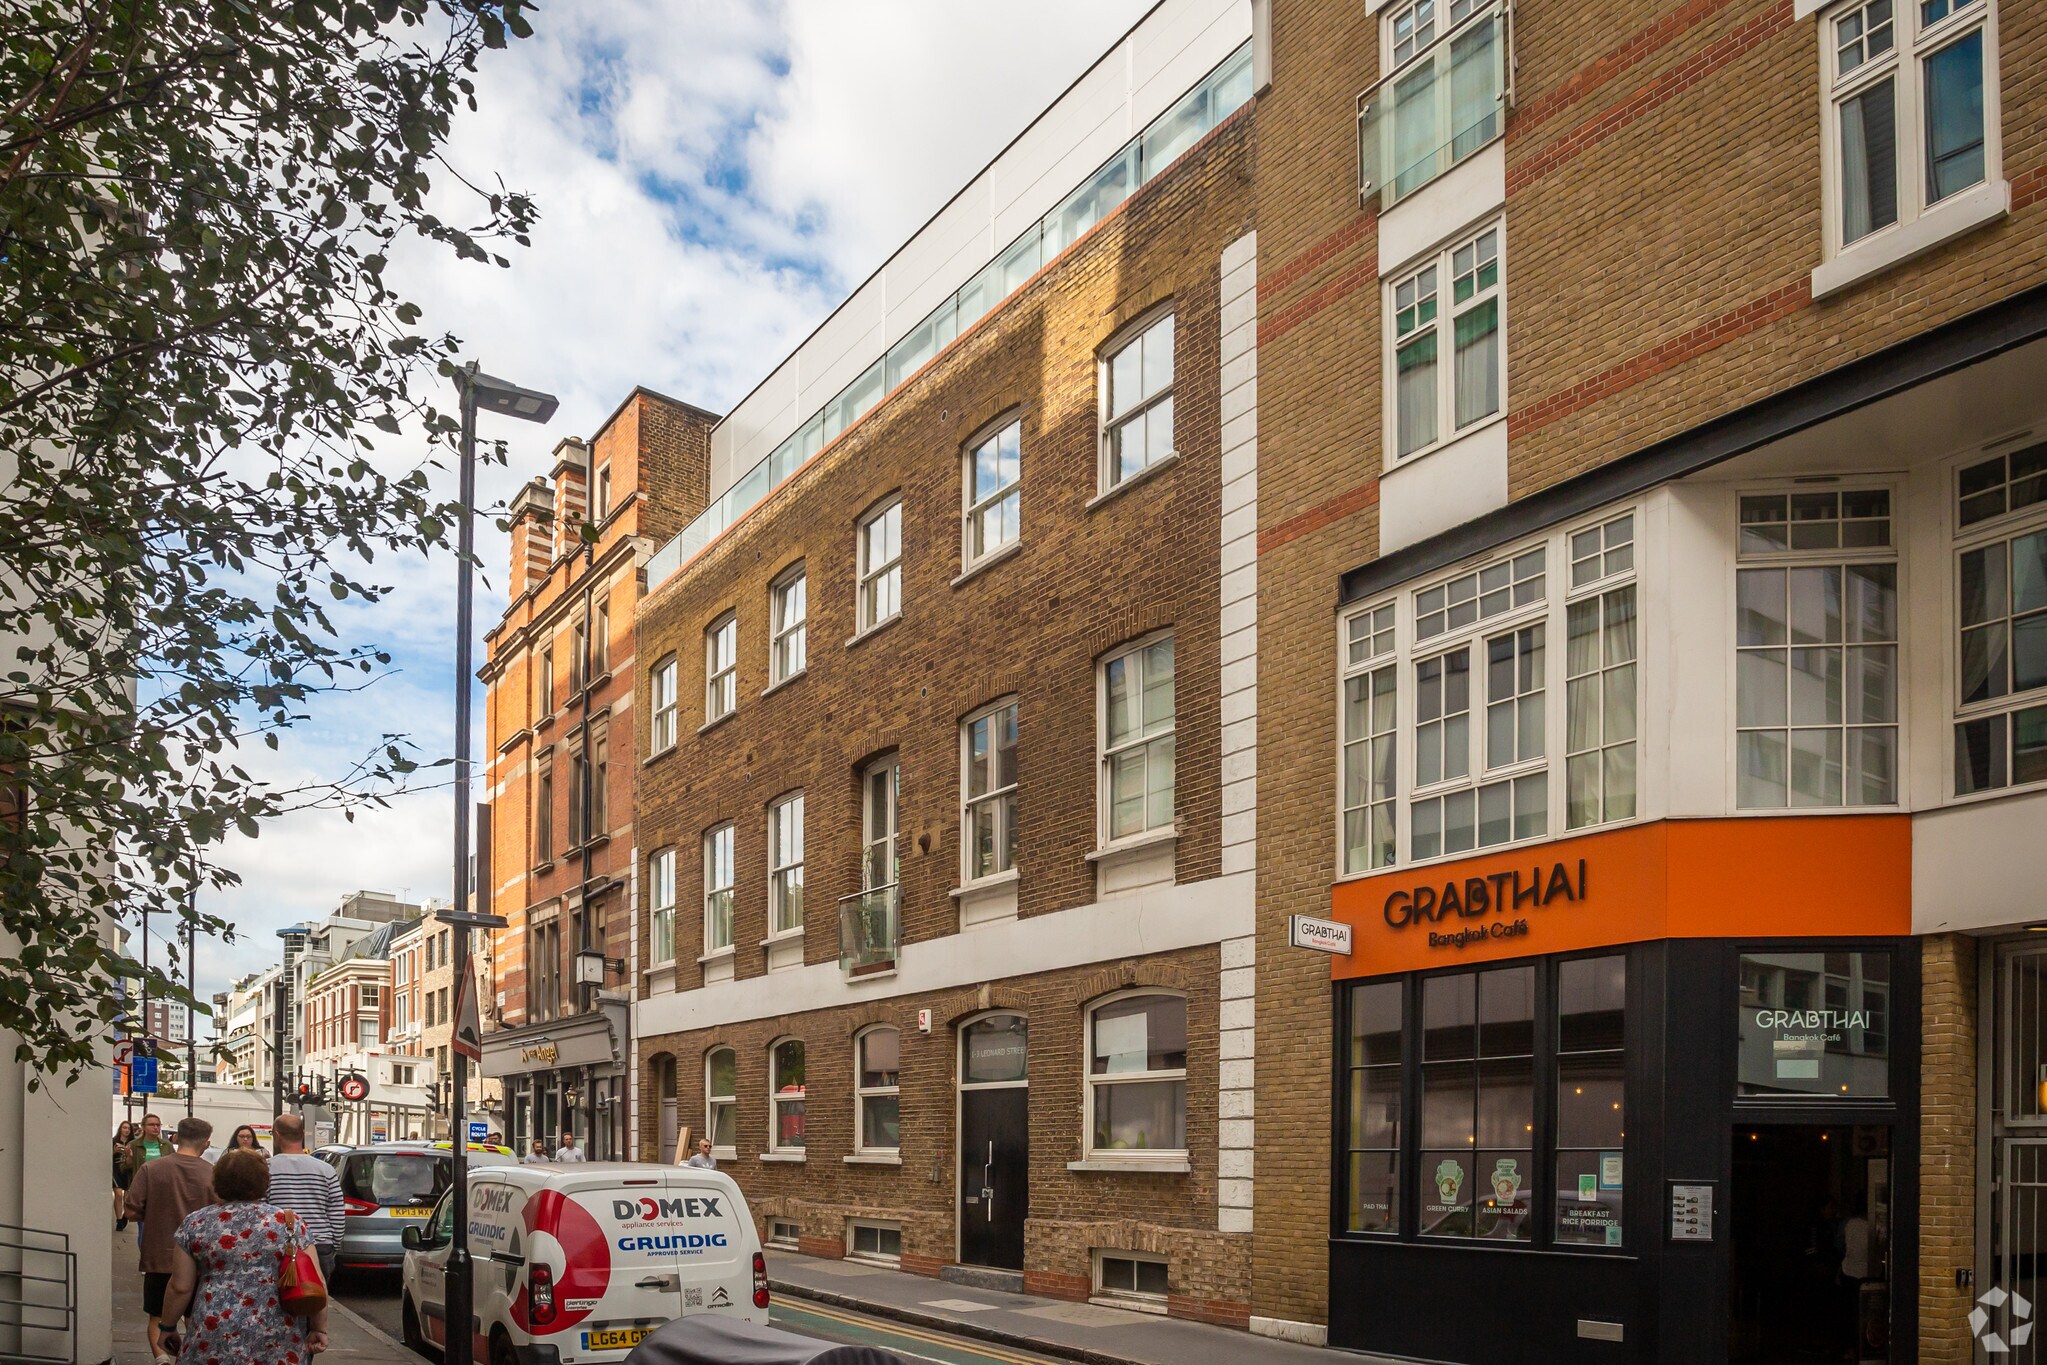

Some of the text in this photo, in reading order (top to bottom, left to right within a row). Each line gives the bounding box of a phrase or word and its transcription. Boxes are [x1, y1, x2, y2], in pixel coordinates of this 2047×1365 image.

[1384, 859, 1586, 928] GRABTHAI
[1301, 923, 1347, 941] GRABTHAI
[1429, 919, 1529, 948] Bangkok Café
[1756, 1010, 1870, 1029] GRABTHAI
[1783, 1033, 1819, 1041] Bangkok
[981, 1048, 1006, 1058] LEONARD
[473, 1188, 514, 1214] DOMEX
[613, 1197, 723, 1221] DOMEX
[1562, 1218, 1618, 1227] RICE PORRIDGE
[1569, 1210, 1610, 1218] BREAKFAST
[468, 1221, 506, 1241] GRUNDIG
[622, 1222, 655, 1230] appliance
[618, 1234, 727, 1251] GRUNDIG
[590, 1331, 627, 1346] LG64
